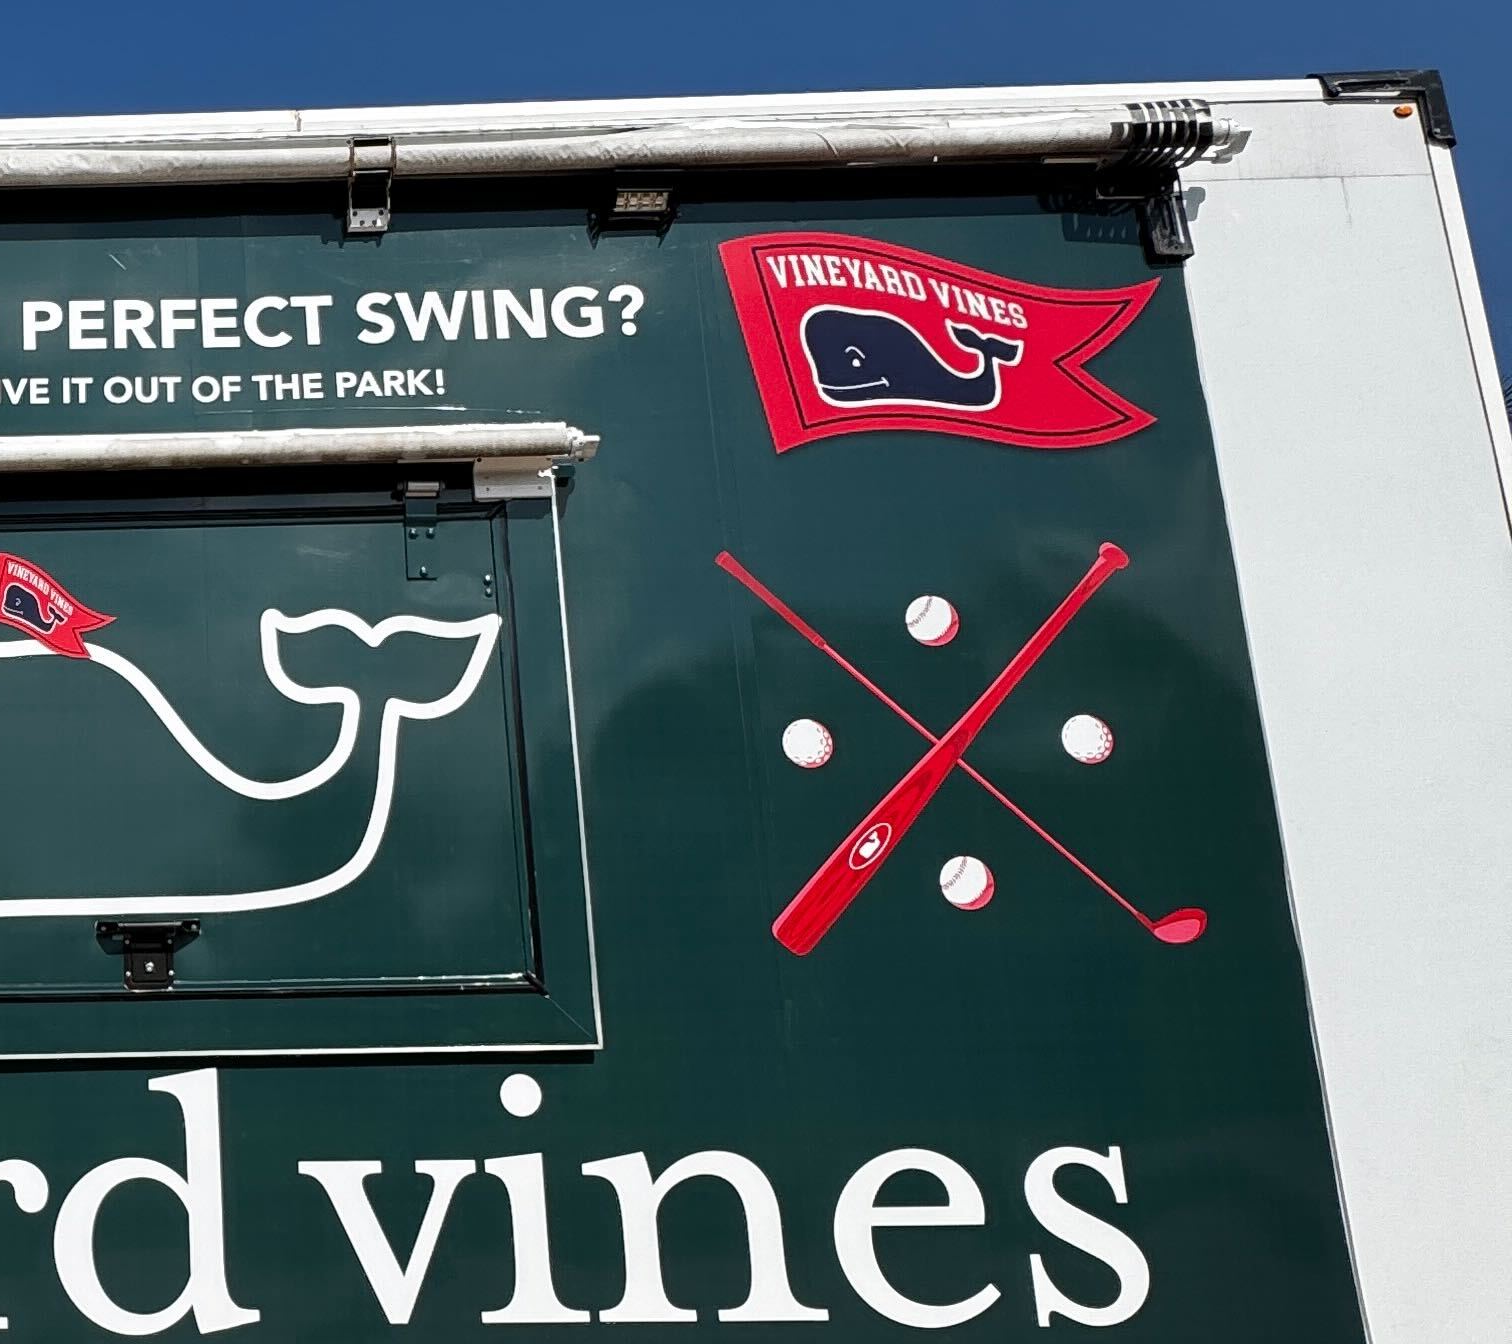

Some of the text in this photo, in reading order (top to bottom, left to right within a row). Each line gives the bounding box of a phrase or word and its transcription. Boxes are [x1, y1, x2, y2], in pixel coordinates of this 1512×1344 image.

[22, 294, 334, 351] PERFECT
[356, 283, 646, 345] SWING?
[765, 253, 1029, 330] VINEYARD VINES
[62, 376, 94, 404] IT
[103, 375, 182, 404] OUT
[191, 374, 242, 403] OF
[251, 372, 325, 401] THE
[335, 368, 446, 398] PARK!
[6, 560, 50, 595] VINEYARD
[297, 1072, 1151, 1330] vines
